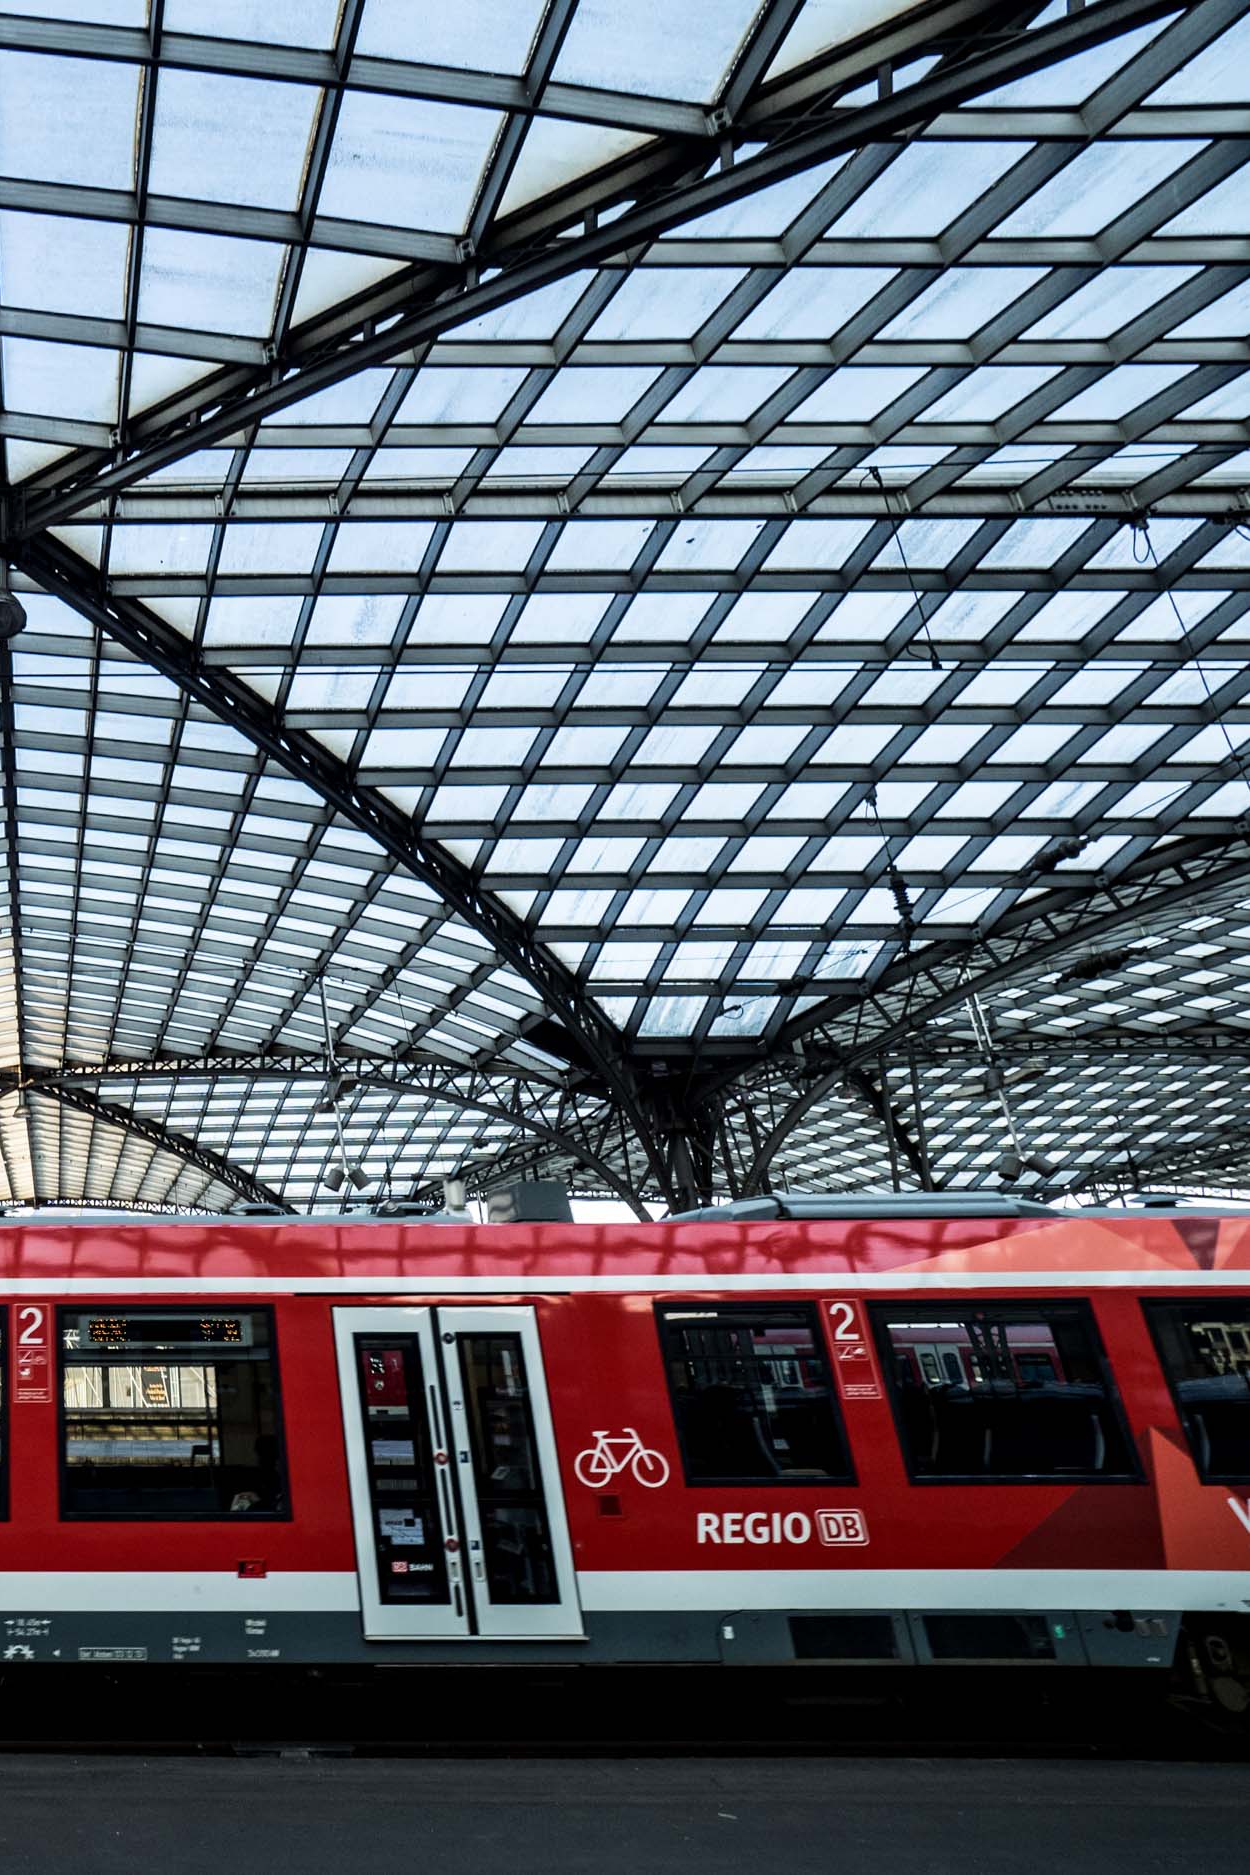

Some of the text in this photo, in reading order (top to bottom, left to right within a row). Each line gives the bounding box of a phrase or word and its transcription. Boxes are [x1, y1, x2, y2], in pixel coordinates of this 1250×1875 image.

[19, 1307, 44, 1345] 2
[830, 1302, 859, 1340] 2
[696, 1512, 863, 1544] REGIO DB
